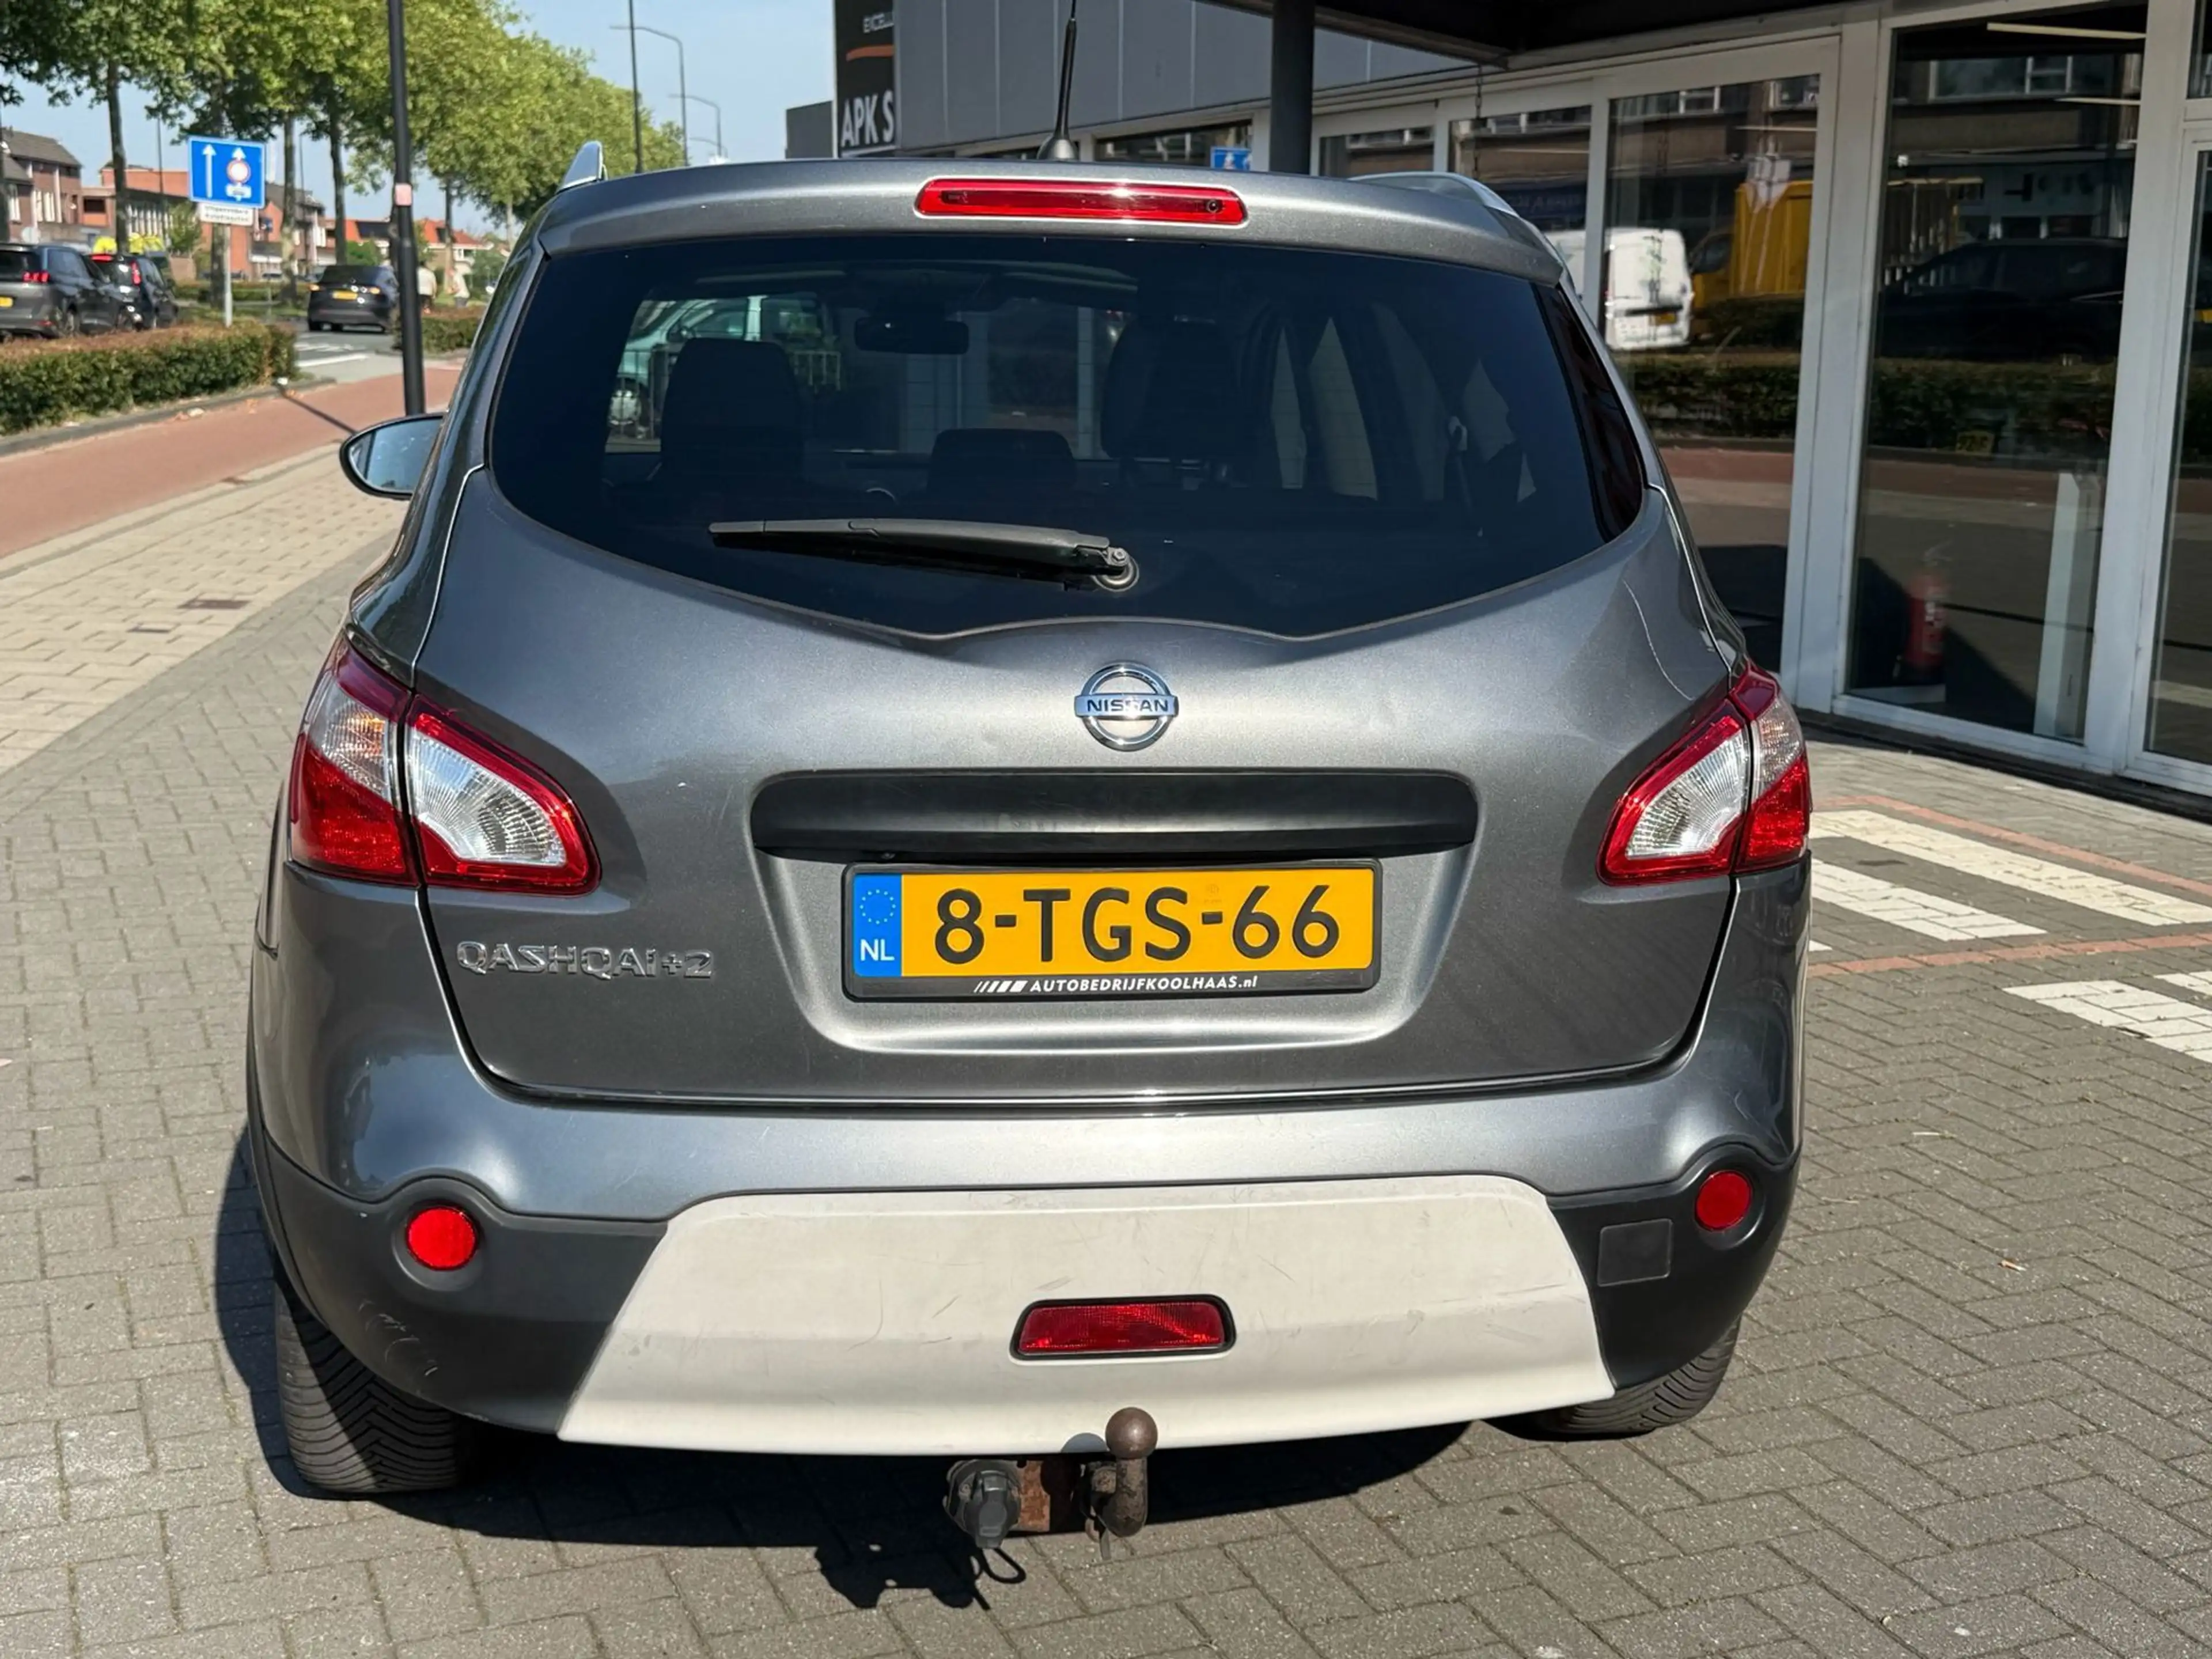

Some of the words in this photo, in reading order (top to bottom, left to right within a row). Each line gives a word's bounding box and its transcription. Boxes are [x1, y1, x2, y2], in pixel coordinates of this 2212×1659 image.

[840, 93, 878, 147] APK
[934, 884, 1340, 964] 8-TGS-66
[859, 938, 895, 961] NL
[1029, 976, 1258, 993] AUTOBEDRIJFKOOLHAAS.nl
